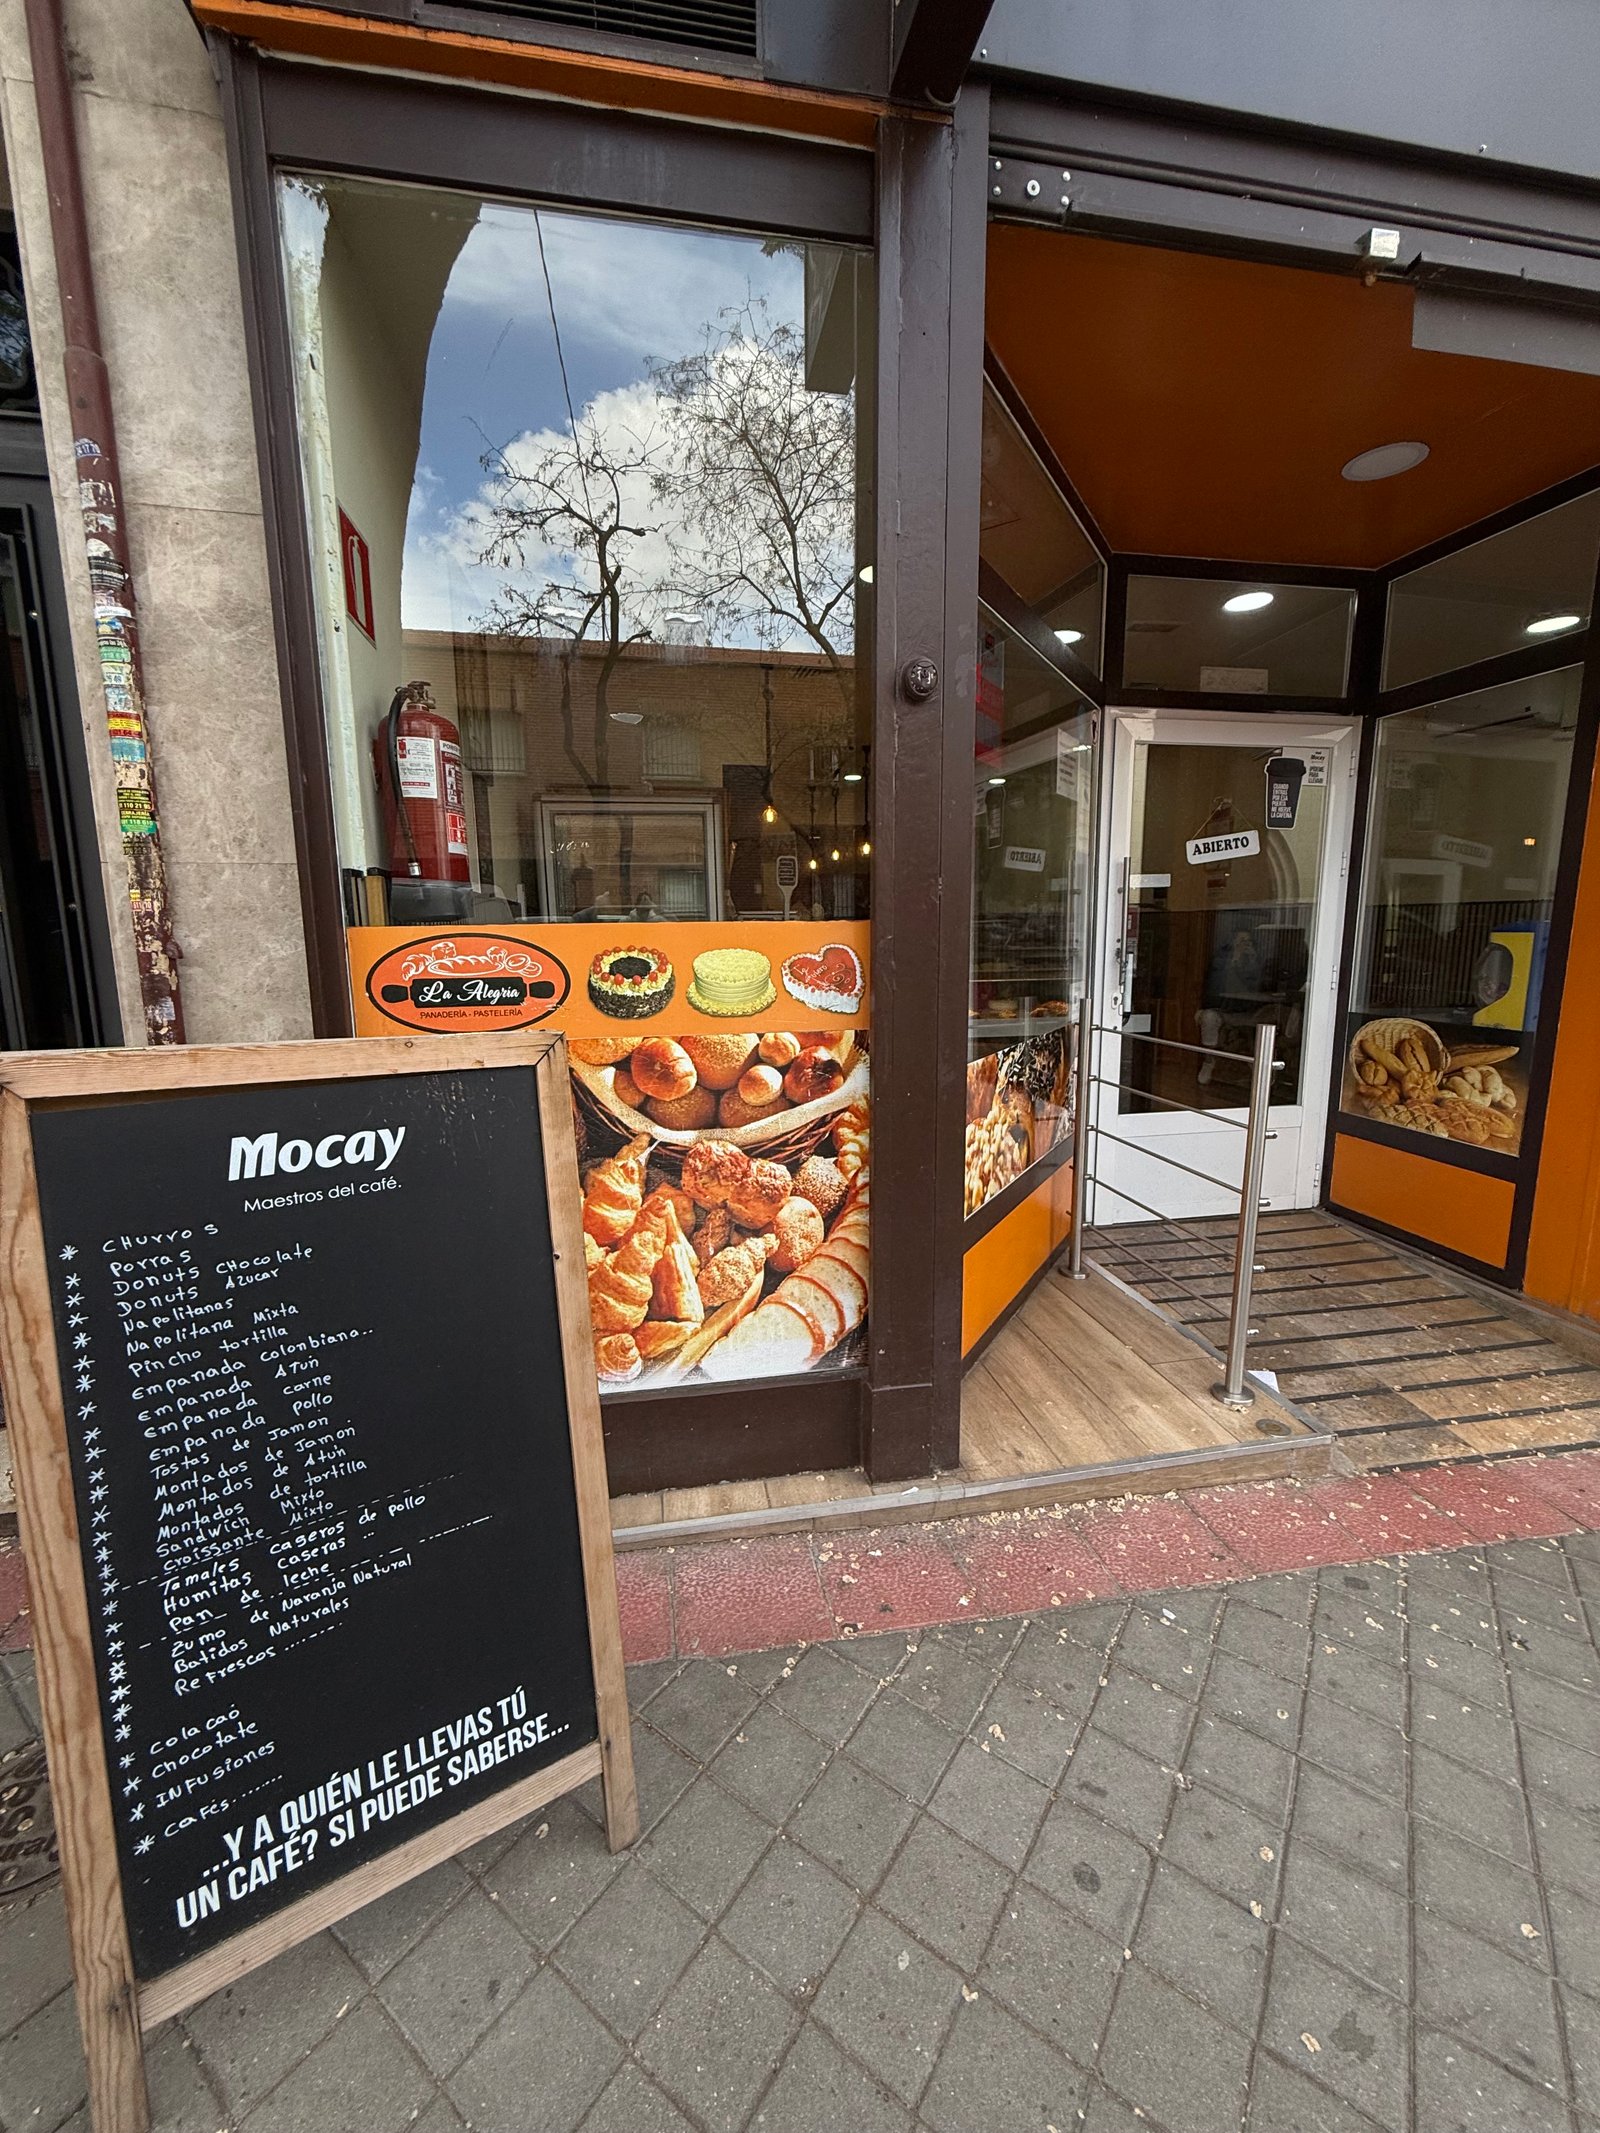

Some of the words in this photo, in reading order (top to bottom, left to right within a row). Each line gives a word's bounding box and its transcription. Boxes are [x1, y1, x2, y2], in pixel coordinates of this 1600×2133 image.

[1192, 836, 1249, 856] ABIERTO
[419, 981, 452, 1003] La
[227, 1126, 407, 1182] Mocay
[244, 1188, 323, 1213] Maestros
[328, 1183, 355, 1199] del
[359, 1175, 402, 1195] café.
[113, 1265, 200, 1296] Donuts
[117, 1285, 199, 1317] Donuts
[123, 1297, 234, 1336] Napolitanas
[126, 1318, 234, 1356] Napolitana
[252, 1303, 299, 1325] Mixta
[219, 1326, 288, 1353] tortilla
[150, 1453, 210, 1480] Tostas
[232, 1437, 250, 1453] de
[154, 1460, 248, 1500] Montados
[264, 1445, 284, 1463] de
[156, 1502, 245, 1543] Montados
[269, 1483, 292, 1501] de
[304, 1459, 367, 1487] tortilla
[158, 1477, 254, 1521] Montados
[272, 1462, 290, 1479] de
[281, 1488, 324, 1514] Mixto
[289, 1502, 334, 1527] Mixto
[158, 1557, 240, 1596] Tamales
[358, 1509, 377, 1526] de
[163, 1572, 252, 1615] Humitas
[239, 1587, 263, 1605] de
[284, 1560, 330, 1588] leche
[249, 1608, 270, 1625] de
[282, 1578, 346, 1612] Naranja
[353, 1553, 412, 1586] Natural
[173, 1637, 248, 1675] Batidos
[269, 1597, 350, 1638] Naturales
[253, 1815, 273, 1850] A
[279, 1766, 360, 1836] QUIÉN
[368, 1749, 400, 1791] LE
[403, 1705, 493, 1776] LLEVAS
[496, 1685, 527, 1727] TÚ
[176, 1879, 221, 1930] UN
[228, 1828, 318, 1902] CAFÉ?
[329, 1812, 355, 1848] SI
[362, 1768, 444, 1832] PUEDE
[447, 1713, 570, 1786] SABERSE...
